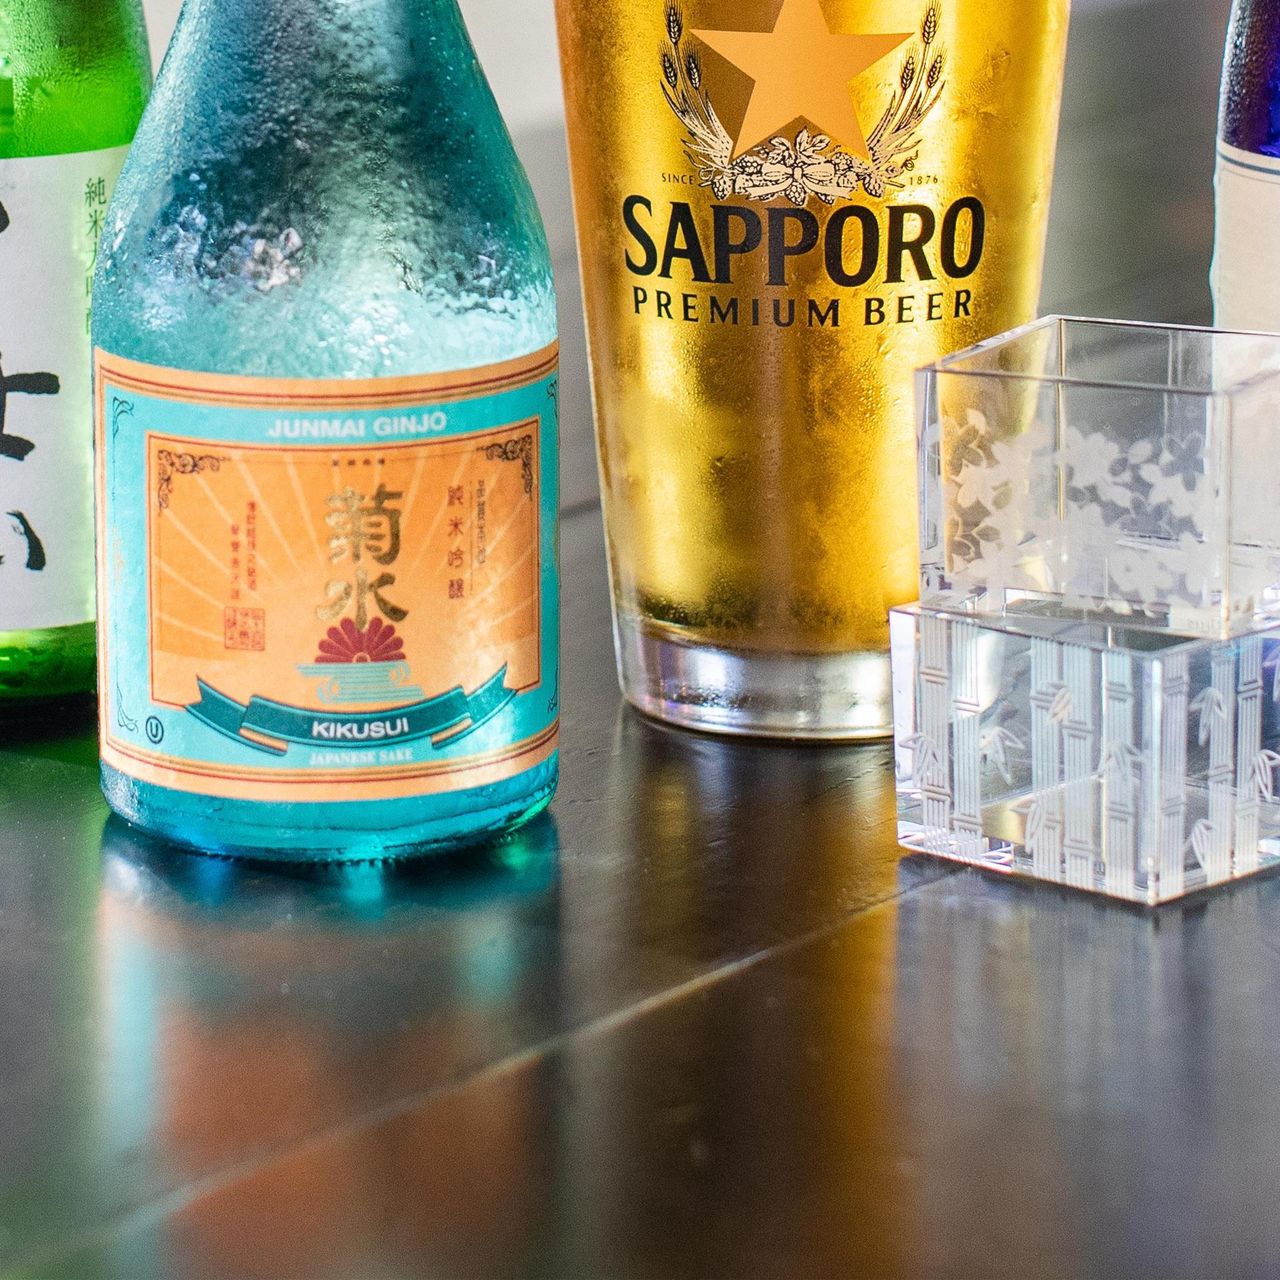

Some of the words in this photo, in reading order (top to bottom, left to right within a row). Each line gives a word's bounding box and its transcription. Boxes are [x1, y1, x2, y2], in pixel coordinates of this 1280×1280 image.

[661, 172, 695, 185] SINCE
[910, 175, 938, 185] 1876
[622, 195, 986, 287] SAPPORO
[632, 285, 840, 328] PREMIUM
[864, 288, 972, 327] BEER
[267, 418, 366, 439] JUNMAI
[373, 411, 448, 436] GINJO
[316, 483, 410, 631] 菊水
[311, 717, 410, 739] KIKUSUI
[309, 751, 376, 766] JAPANESE
[380, 748, 413, 763] SAKE
